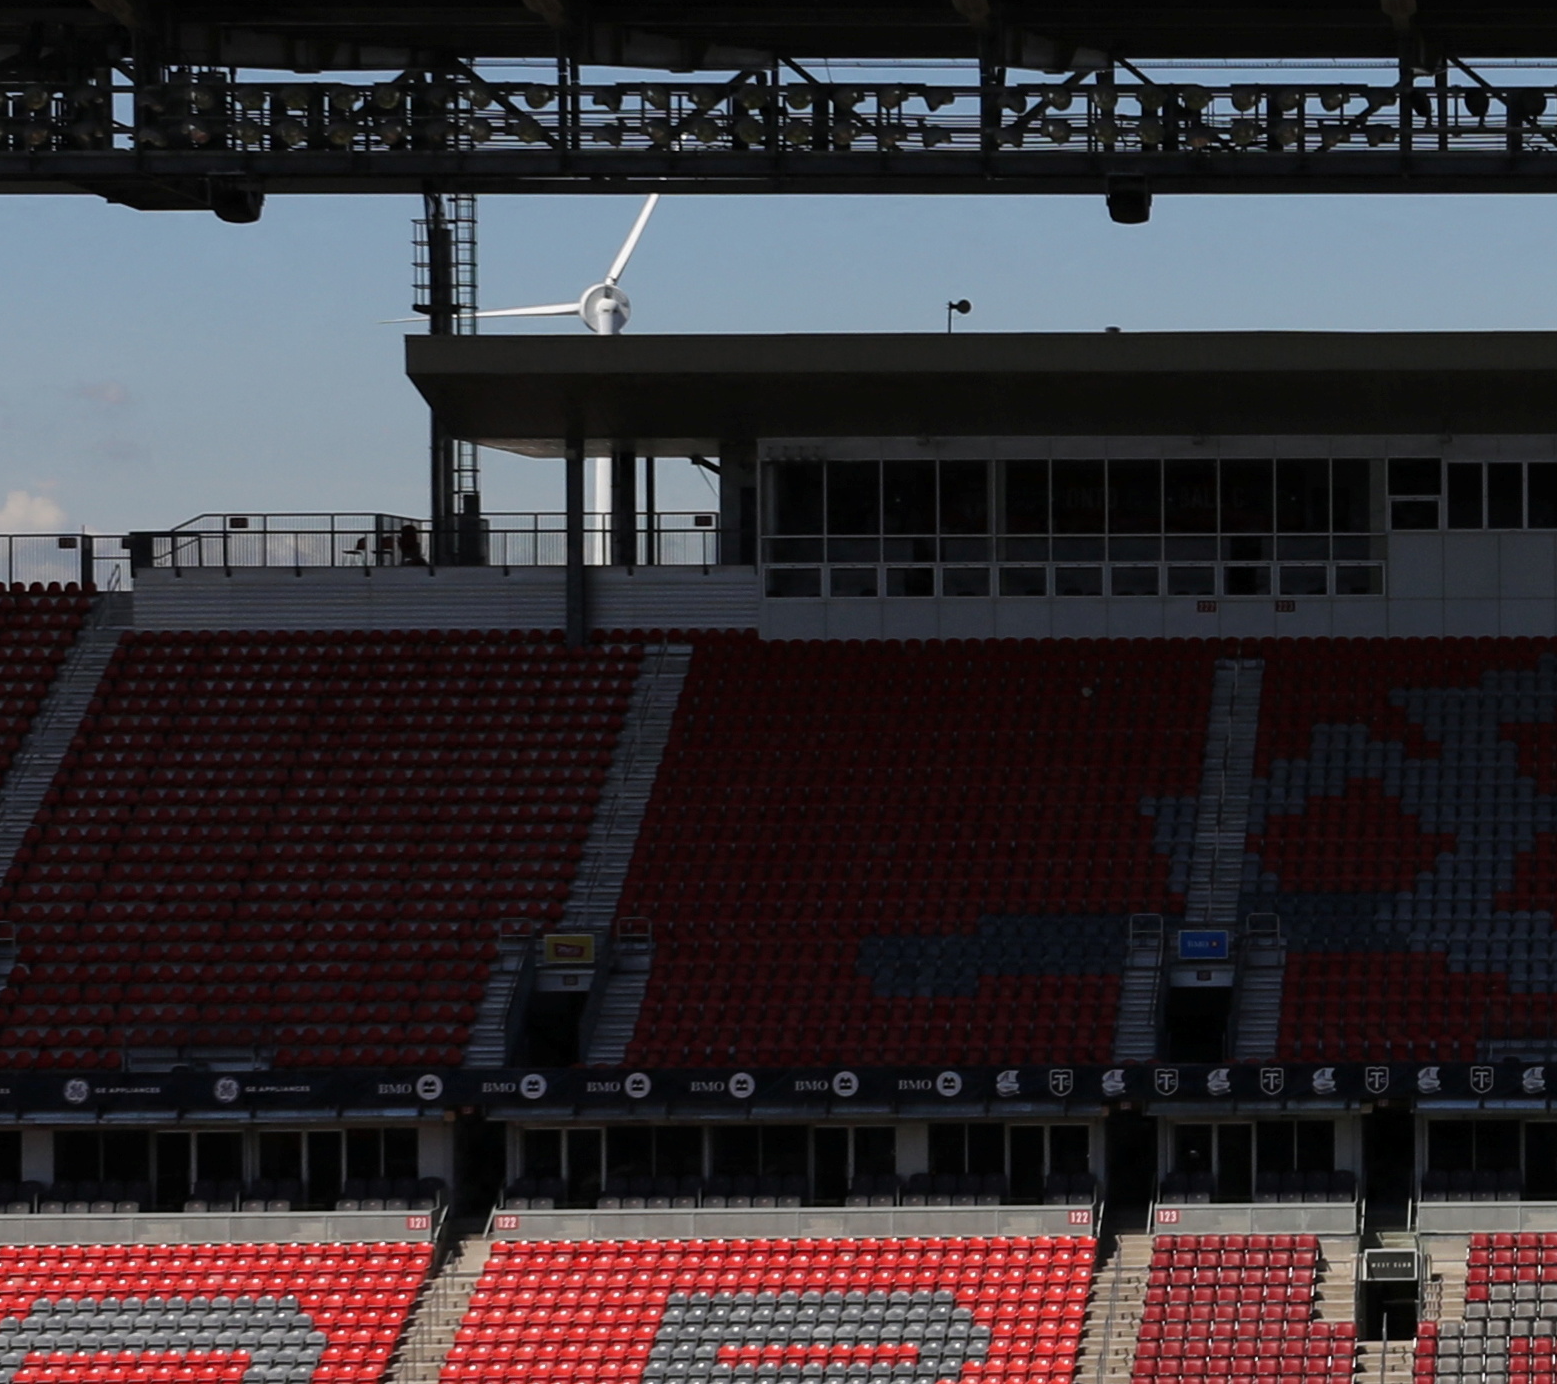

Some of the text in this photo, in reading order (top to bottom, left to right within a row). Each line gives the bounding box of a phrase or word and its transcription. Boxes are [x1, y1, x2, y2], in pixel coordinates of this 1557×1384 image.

[109, 1086, 161, 1095] APPLIANCES
[259, 1085, 311, 1094] APPLIANCES
[378, 1082, 413, 1095] BMO
[482, 1081, 517, 1094] BMO
[586, 1080, 622, 1093] BMO
[690, 1080, 725, 1093] BMO
[794, 1079, 829, 1092] BMO
[897, 1079, 932, 1091] BMO
[1071, 1211, 1088, 1223] 122
[1159, 1210, 1177, 1222] 123
[409, 1217, 426, 1228] 121
[499, 1217, 515, 1228] 122
